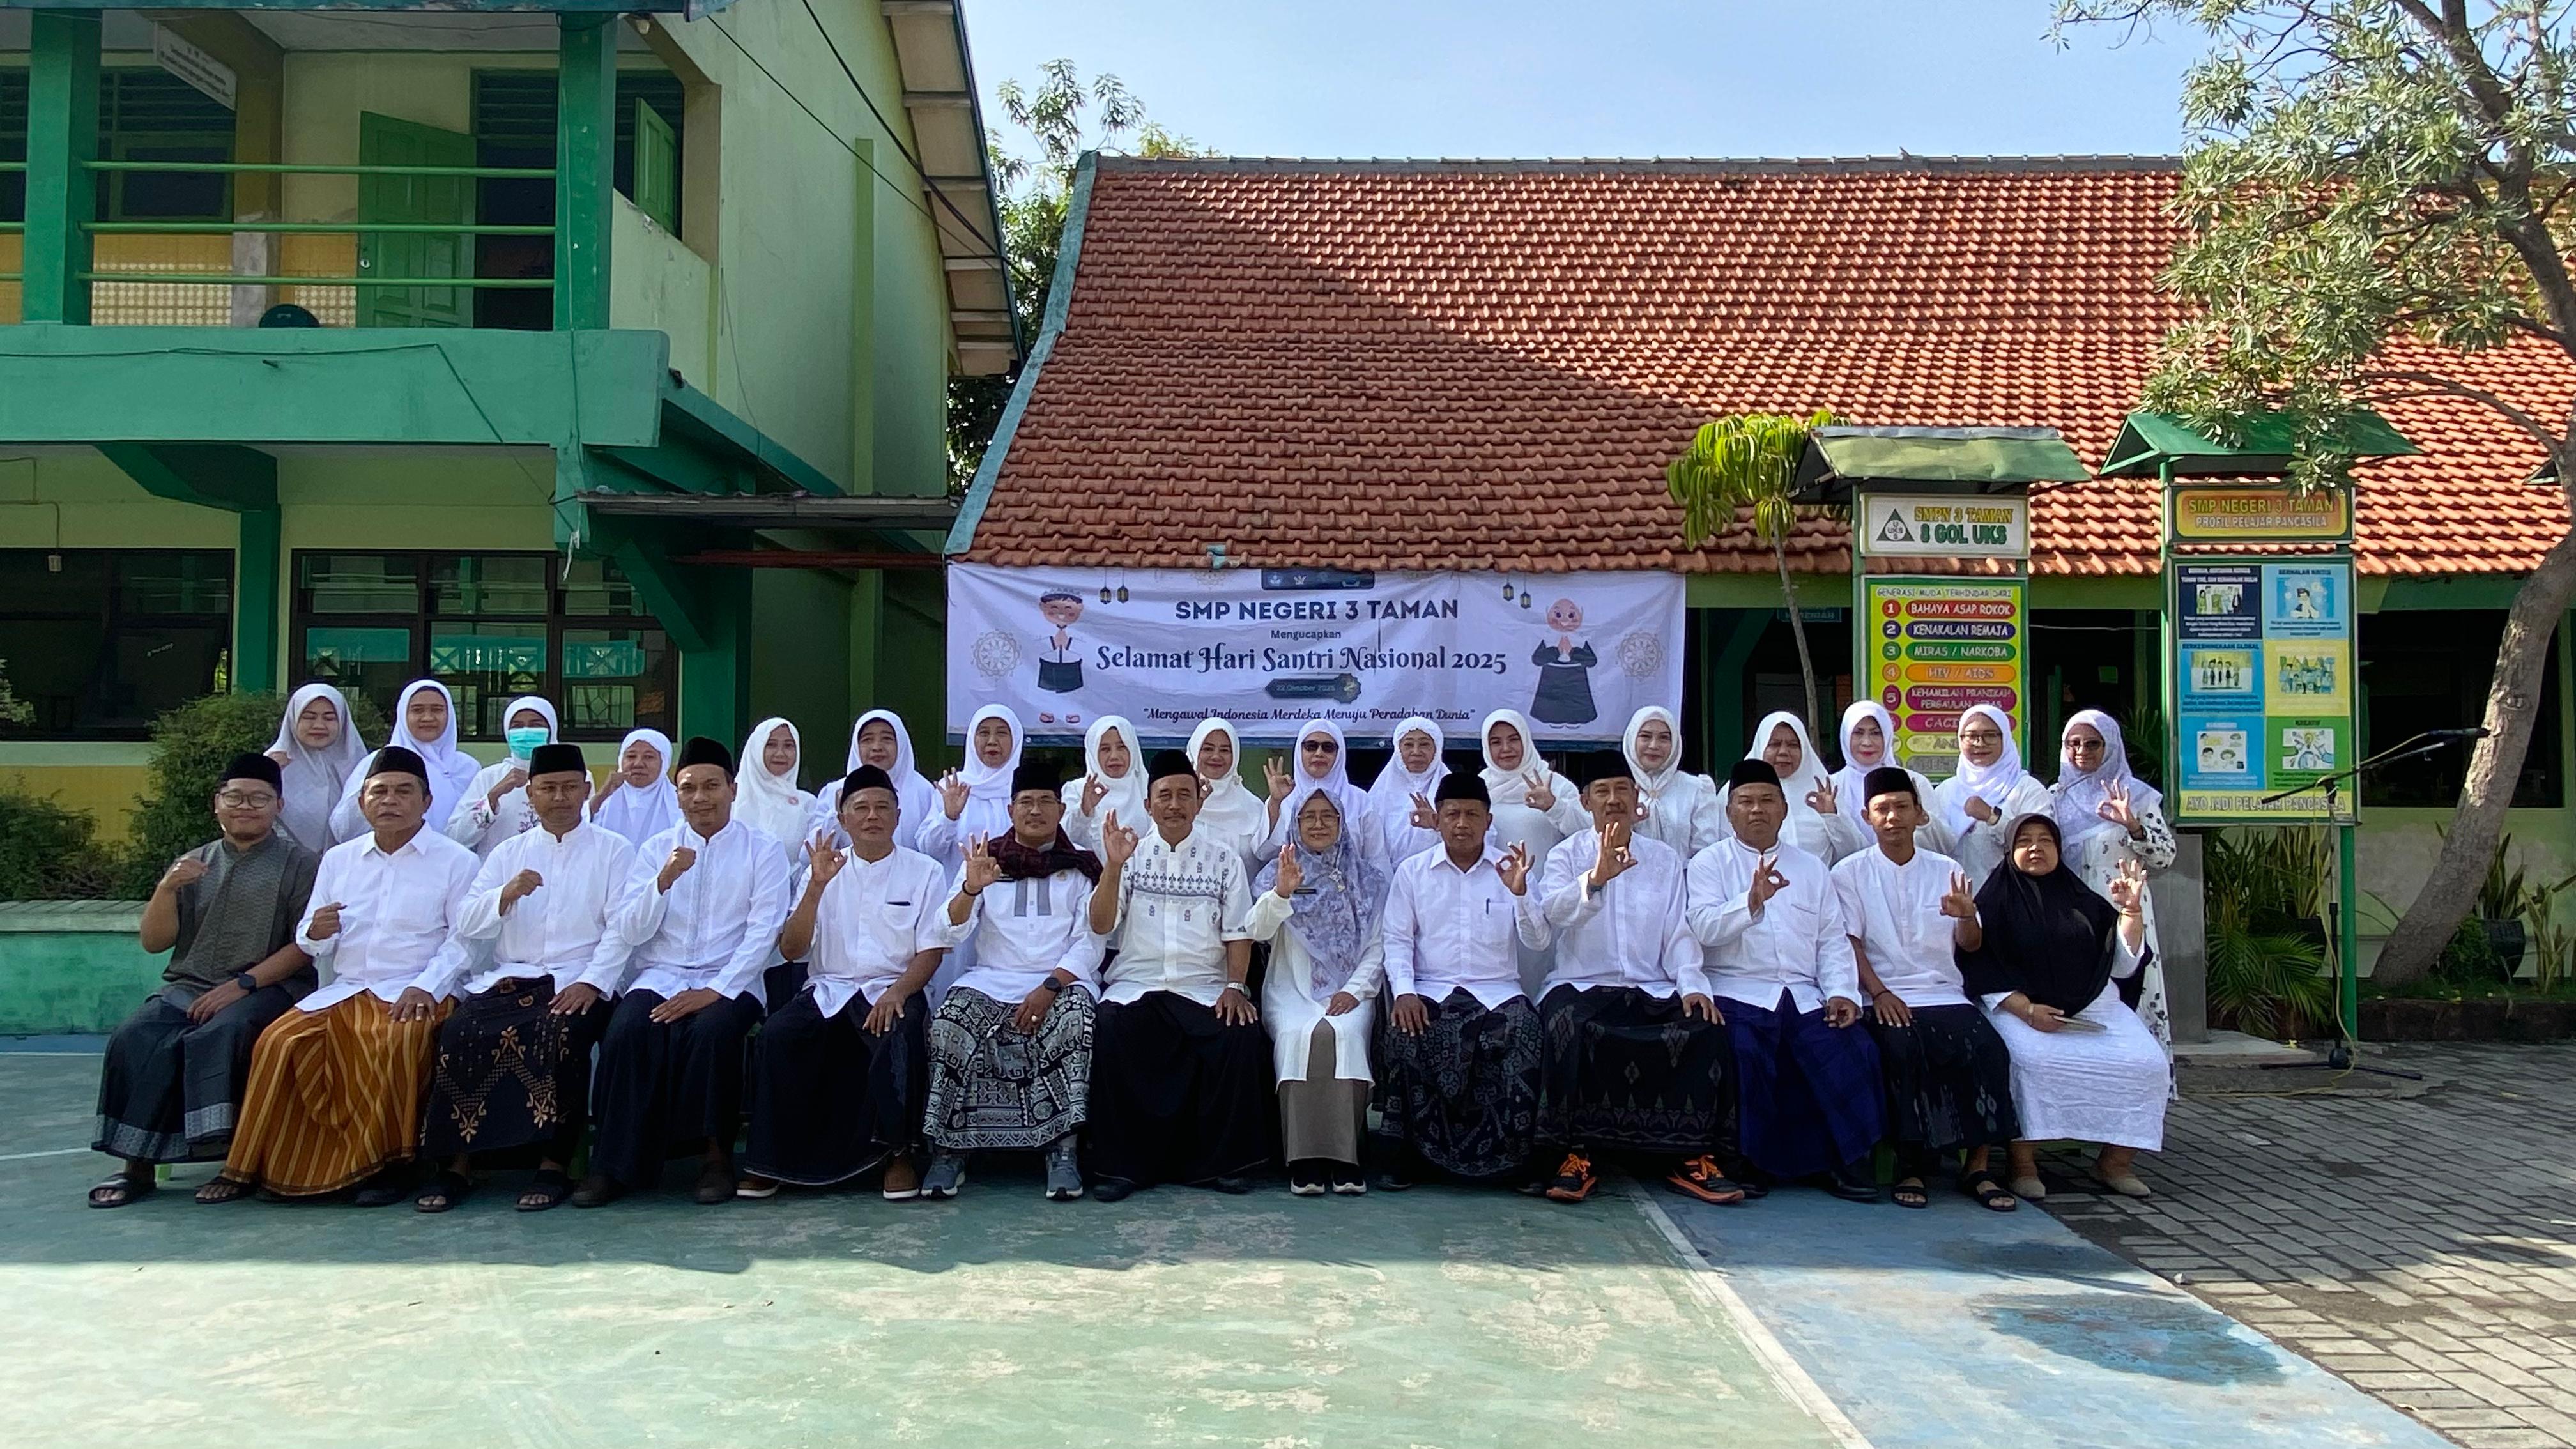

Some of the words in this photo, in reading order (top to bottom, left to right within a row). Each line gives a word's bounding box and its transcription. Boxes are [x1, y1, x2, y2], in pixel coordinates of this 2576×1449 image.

[2188, 500, 2216, 513] SMP
[2220, 500, 2272, 514] NEGERI
[2276, 501, 2283, 513] 3
[2288, 500, 2333, 512] TAMAN
[1914, 507, 1952, 522] SMPN
[1954, 507, 1963, 523] 3
[1965, 508, 2014, 524] TAMAN
[2196, 517, 2230, 527] PROFIL
[2232, 517, 2273, 528] PELAJAR
[2275, 516, 2327, 527] PANCASILA
[1934, 524, 1968, 544] GOL
[1972, 525, 2007, 544] UKS
[1876, 587, 1915, 597] GENERASI
[1919, 588, 1942, 597] MUDA
[1175, 601, 1230, 620] SMP
[1239, 601, 1337, 620] NEGERI
[1346, 601, 1359, 620] 3
[1367, 599, 1458, 619] TAMAN
[1887, 604, 1894, 614] 1
[1910, 604, 1949, 615] BAHAYA
[1953, 604, 1977, 615] ASAP
[1979, 604, 2011, 615] ROKOK
[1271, 629, 1342, 640] Mengucapkan
[1887, 624, 1896, 634] 2
[1913, 625, 1968, 636] KENAKALAN
[1971, 625, 2008, 636] REMAJA
[1887, 645, 1896, 656] 3
[1913, 647, 1948, 657] MIRAS
[1961, 646, 2007, 657] NARKOBA
[1096, 645, 1193, 670] Selamat
[1197, 641, 1255, 674] Hari
[1262, 647, 1333, 672] Santri
[1340, 645, 1445, 671] Nasional
[1452, 653, 1506, 674] 2025
[1929, 667, 1949, 678] HIV
[1887, 693, 1896, 703] 5
[1210, 708, 1269, 719] Indonesia
[1271, 709, 1321, 719] Merdeka
[1324, 709, 1367, 723] Menuju
[1370, 707, 1434, 719] Peradaban
[2186, 797, 2209, 810] AYO
[2210, 797, 2234, 811] JADI
[2285, 797, 2345, 811] PANCASLA
